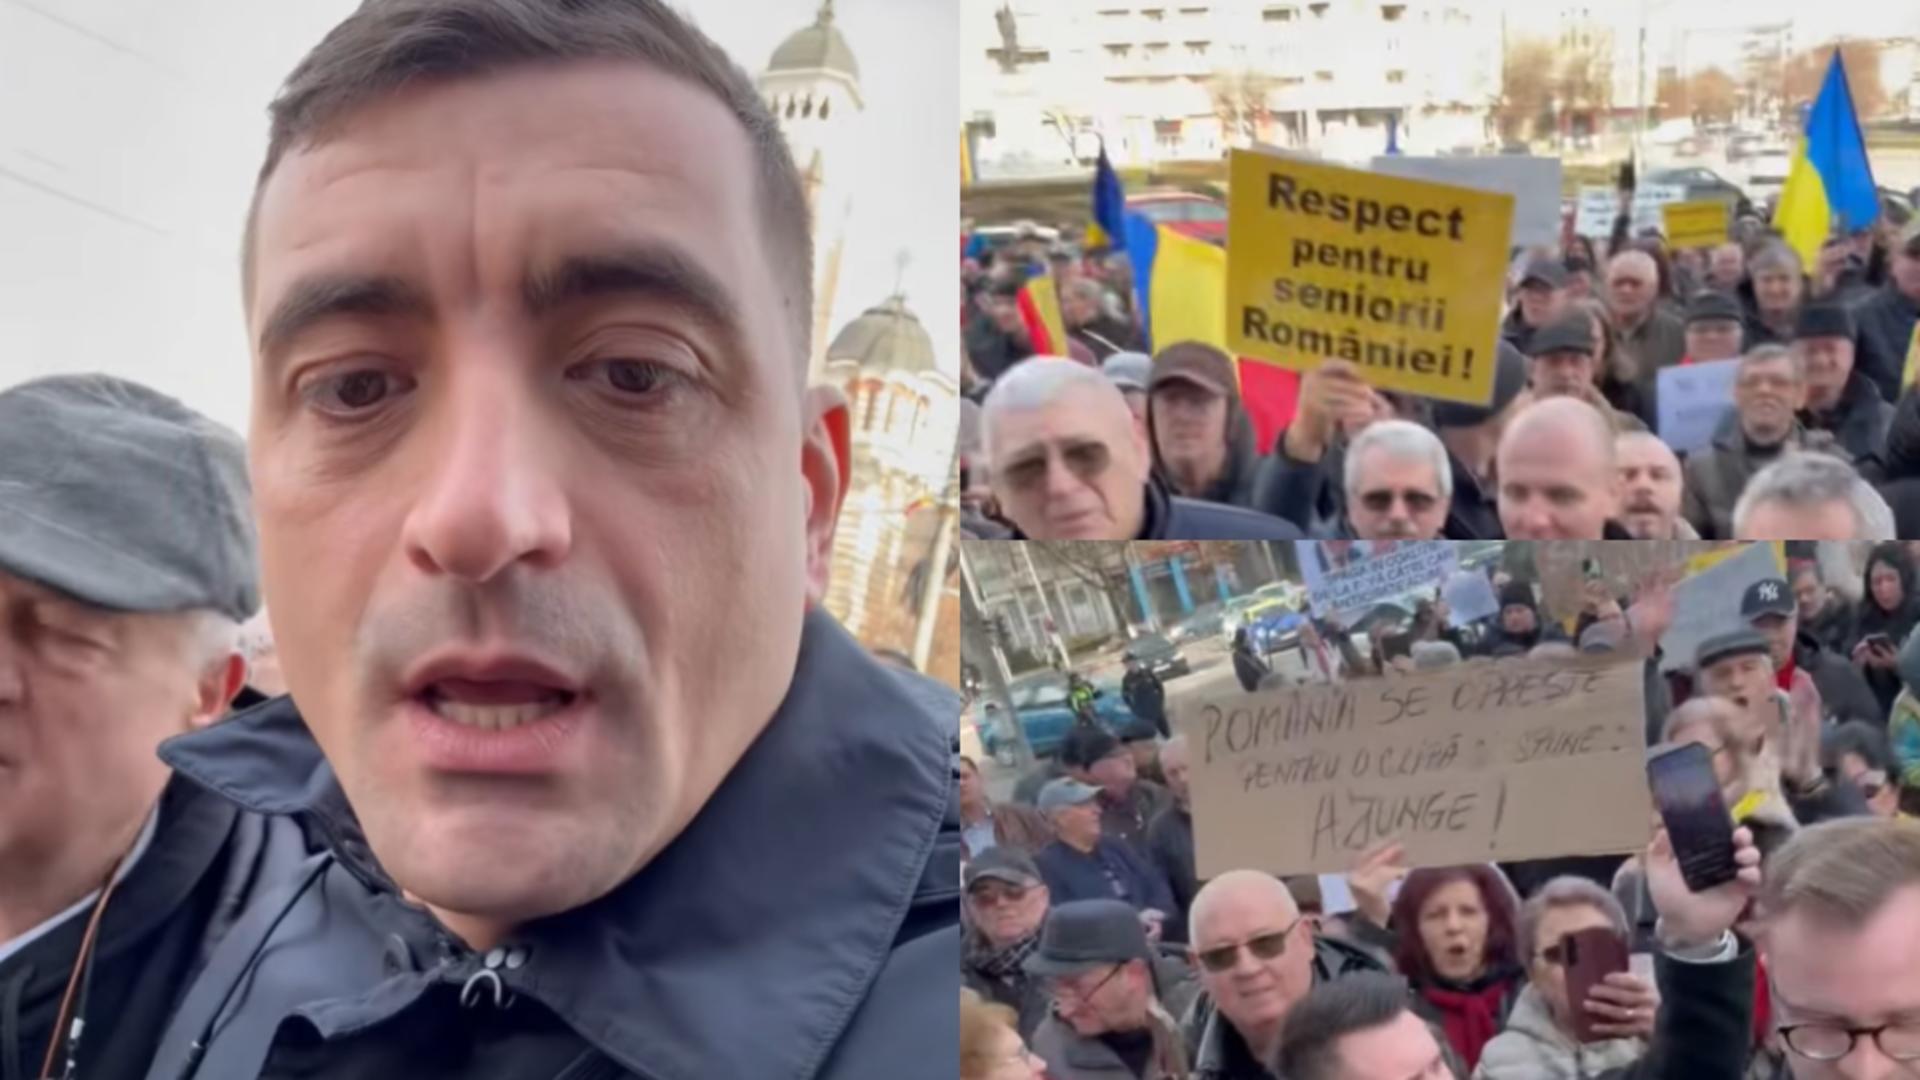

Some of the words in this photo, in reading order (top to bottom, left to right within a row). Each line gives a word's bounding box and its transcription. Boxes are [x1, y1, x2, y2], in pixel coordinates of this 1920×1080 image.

[1268, 173, 1465, 241] Respect
[1292, 237, 1430, 283] pentru
[1273, 277, 1447, 332] seniorii
[1376, 686, 1430, 725] SE
